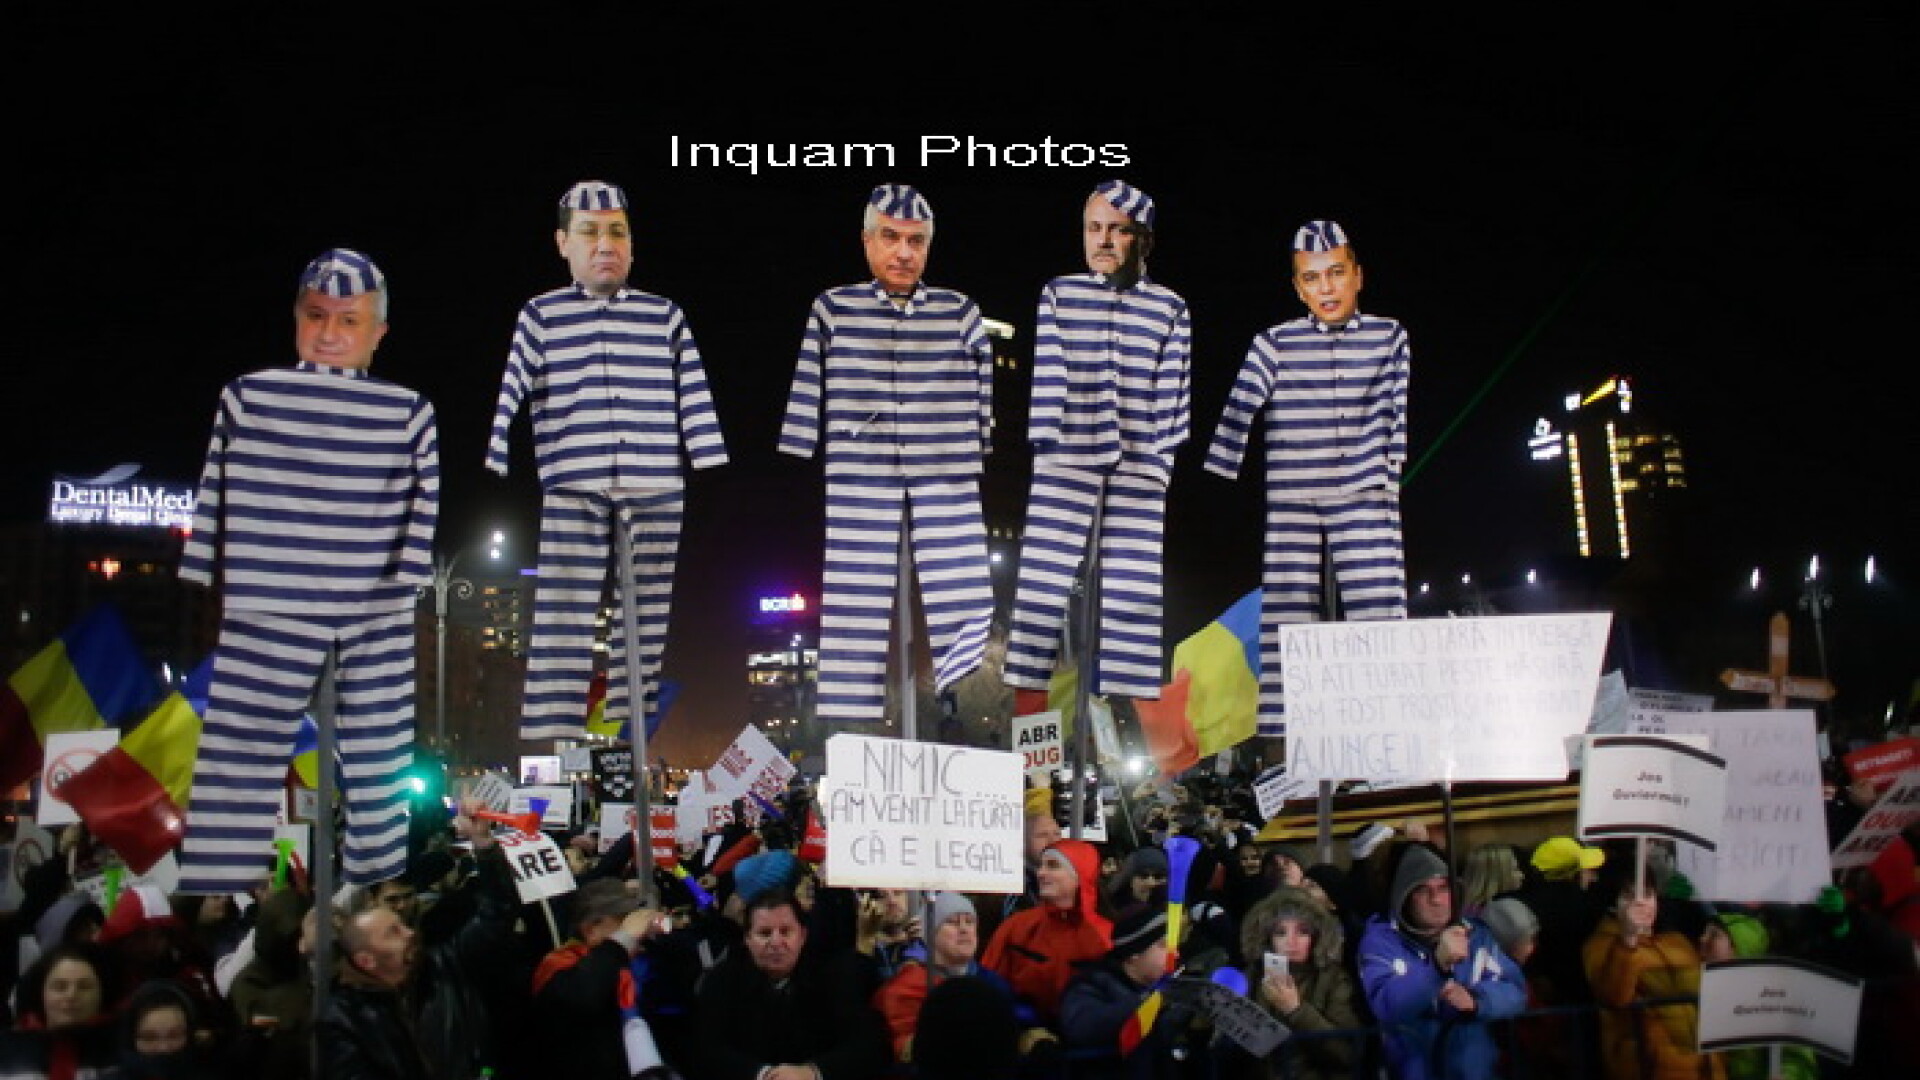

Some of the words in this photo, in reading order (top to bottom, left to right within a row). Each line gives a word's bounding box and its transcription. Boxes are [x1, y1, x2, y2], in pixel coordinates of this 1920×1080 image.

[52, 481, 192, 510] DentalMed
[1018, 723, 1060, 747] ABR
[830, 788, 865, 824] AM
[869, 793, 936, 824] VENIT
[515, 846, 562, 882] RE
[901, 835, 919, 866] E
[934, 838, 1013, 874] LEGAL
